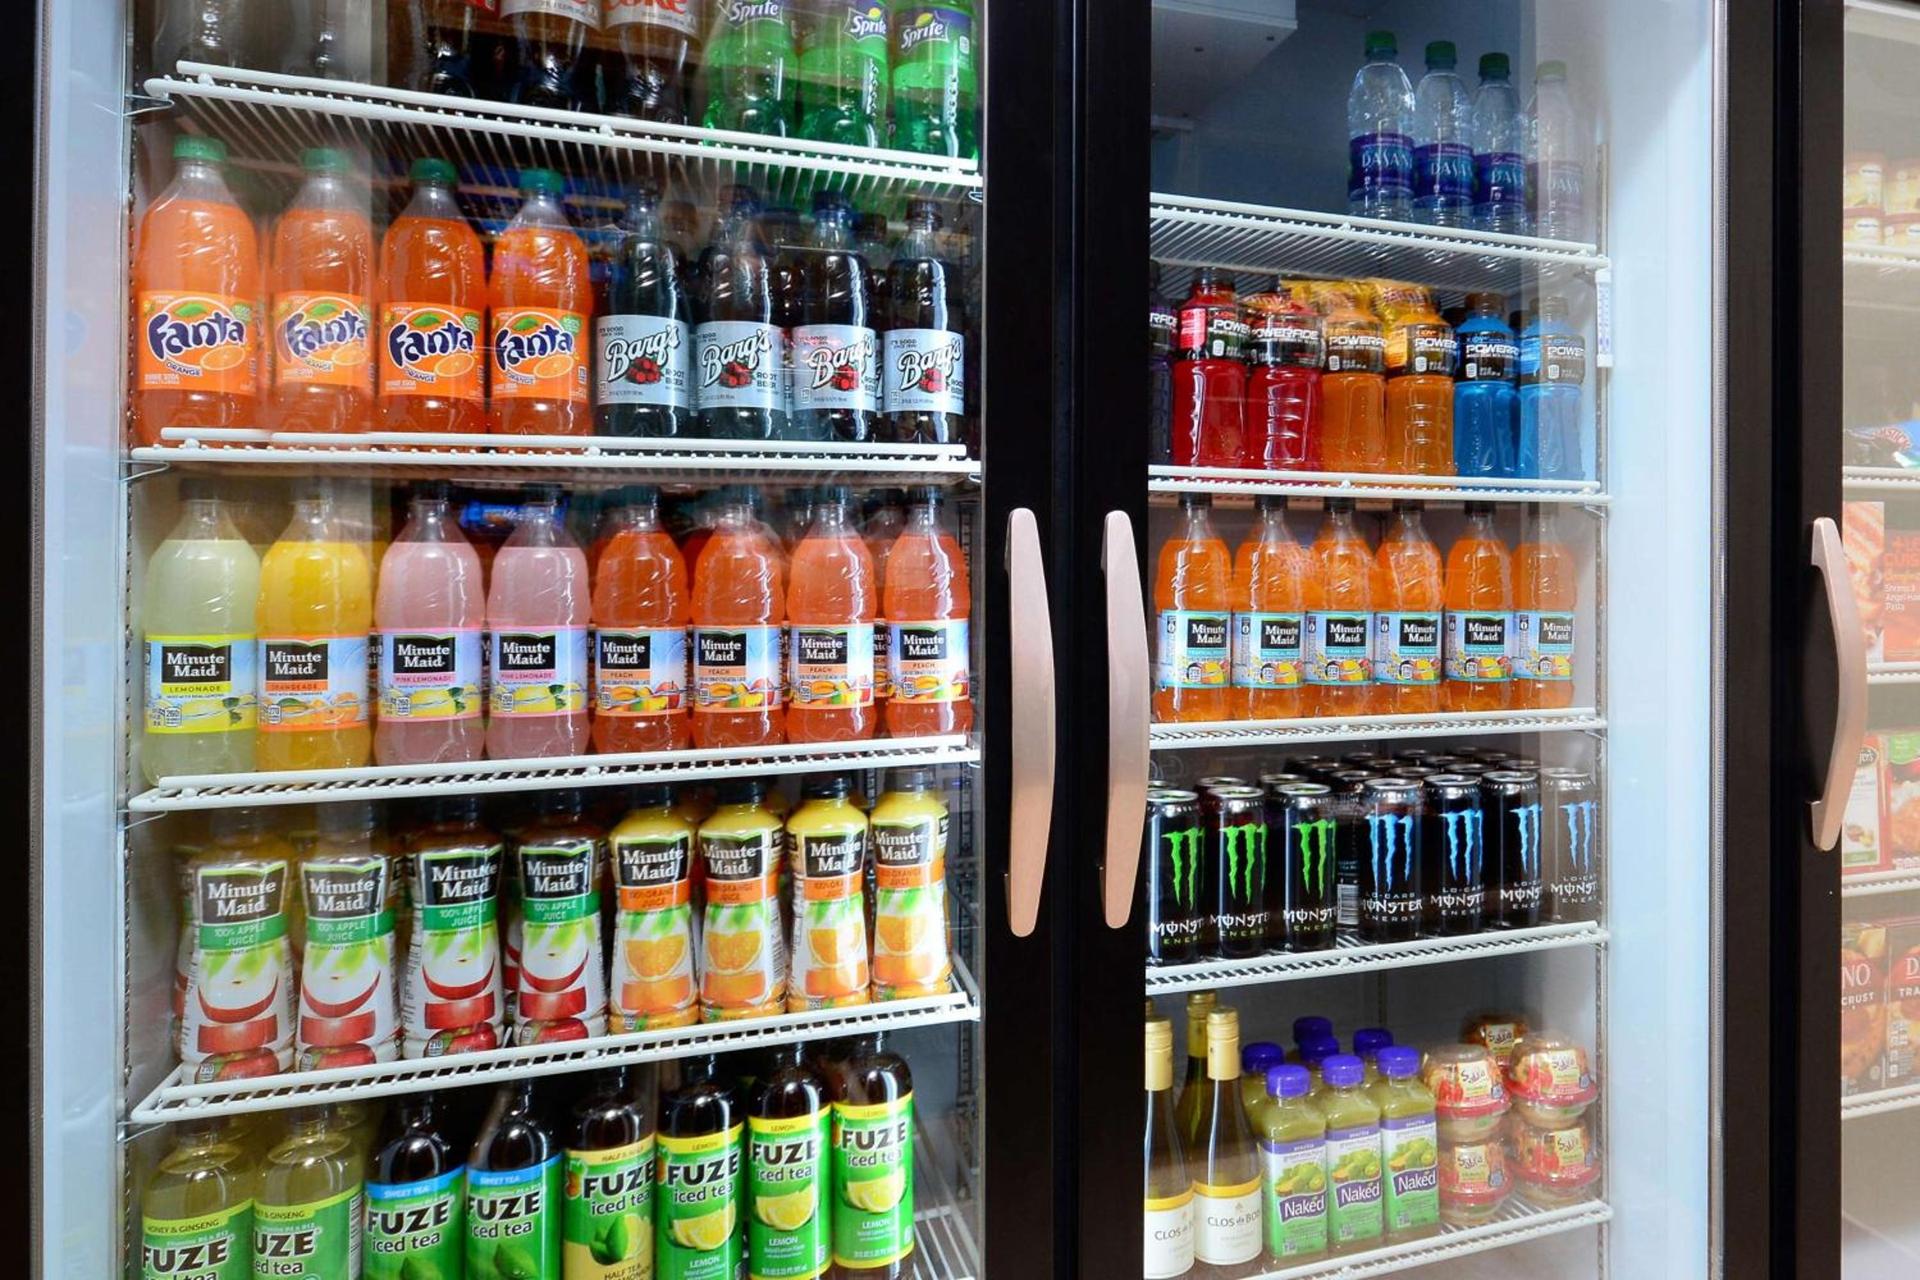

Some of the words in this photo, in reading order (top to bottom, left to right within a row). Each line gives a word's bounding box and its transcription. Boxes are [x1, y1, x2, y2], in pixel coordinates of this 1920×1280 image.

[850, 16, 887, 36] Sprite
[901, 22, 945, 49] Sprite
[1362, 149, 1412, 169] DASANI
[149, 310, 245, 361] Fanta
[286, 309, 366, 359] Fanta
[1251, 327, 1319, 340] POWERADE
[389, 319, 474, 368] Fanta
[495, 324, 574, 371] Fanta
[605, 323, 681, 383] Barg's
[702, 328, 772, 388] Barg's
[809, 334, 874, 389] Barg's
[898, 336, 961, 391] Barg's
[1192, 624, 1225, 634] Minute
[1265, 625, 1299, 635] Minute
[1330, 624, 1364, 633] Minute
[1403, 624, 1436, 634] Minute
[1468, 623, 1502, 632] Minute
[1543, 622, 1571, 631] Minute
[801, 638, 843, 649] Minute
[903, 634, 945, 645] Minute
[1196, 634, 1223, 644] Maid
[1270, 635, 1296, 645] Maid
[1334, 633, 1361, 643] Maid
[1408, 633, 1434, 642] Maid
[1473, 632, 1499, 641] Maid
[1547, 631, 1569, 641] Maid
[399, 644, 450, 656] Minute
[503, 642, 550, 653] Minute
[603, 642, 645, 653] Minute
[701, 639, 741, 650] Minute
[909, 645, 940, 656] Maid
[167, 652, 225, 665] Minute
[269, 651, 321, 663] Minute
[405, 656, 443, 668] Maid
[508, 653, 545, 665] Maid
[607, 653, 638, 665] Maid
[705, 650, 736, 662] Maid
[806, 649, 838, 660] Maid
[174, 665, 218, 677] Maid
[275, 663, 314, 675] Maid
[876, 831, 924, 846] Minute
[704, 844, 756, 859] Minute
[811, 840, 861, 857] Minute
[881, 845, 920, 861] Maid
[623, 848, 684, 865] Minute
[818, 853, 856, 872] Maid
[432, 862, 498, 882] Minute
[526, 860, 584, 876] Minute
[632, 863, 676, 881] Maid
[709, 858, 751, 876] Maid
[208, 880, 276, 900] Minute
[309, 878, 375, 894] Minute
[441, 879, 489, 898] Maid
[534, 876, 577, 893] Maid
[216, 898, 268, 917] Maid
[317, 894, 367, 912] Maid
[462, 904, 487, 916] APPLE
[552, 900, 577, 911] APPLE
[451, 916, 478, 928] JUICE
[542, 910, 567, 920] JUICE
[1283, 907, 1338, 924] MONST
[238, 922, 267, 935] APPLE
[336, 920, 366, 931] APPLE
[226, 935, 256, 946] JUICE
[327, 931, 354, 941] JUICE
[842, 1121, 906, 1150] FUZE
[752, 1138, 817, 1165] FUZE
[668, 1152, 738, 1186] FUZE
[790, 1165, 813, 1179] tea
[584, 1159, 655, 1198] FUZE
[1398, 1171, 1436, 1192] Naked
[674, 1186, 706, 1203] iced
[711, 1183, 734, 1197] tea
[1341, 1183, 1380, 1204] Naked
[468, 1192, 540, 1222] FUZE
[591, 1197, 626, 1215] iced
[1284, 1195, 1325, 1218] Naked
[272, 1210, 304, 1219] GINSENG
[368, 1200, 450, 1234] FUZE
[1208, 1216, 1236, 1228] CLOS
[179, 1219, 220, 1232] GINSENG
[504, 1221, 532, 1237] tea
[769, 1236, 799, 1246] LEMON
[1154, 1226, 1181, 1241] CLOS
[372, 1237, 406, 1253] iced
[412, 1232, 440, 1249] tea
[143, 1238, 228, 1273] FUZE
[690, 1256, 720, 1268] LEMON
[274, 1260, 303, 1275] tea
